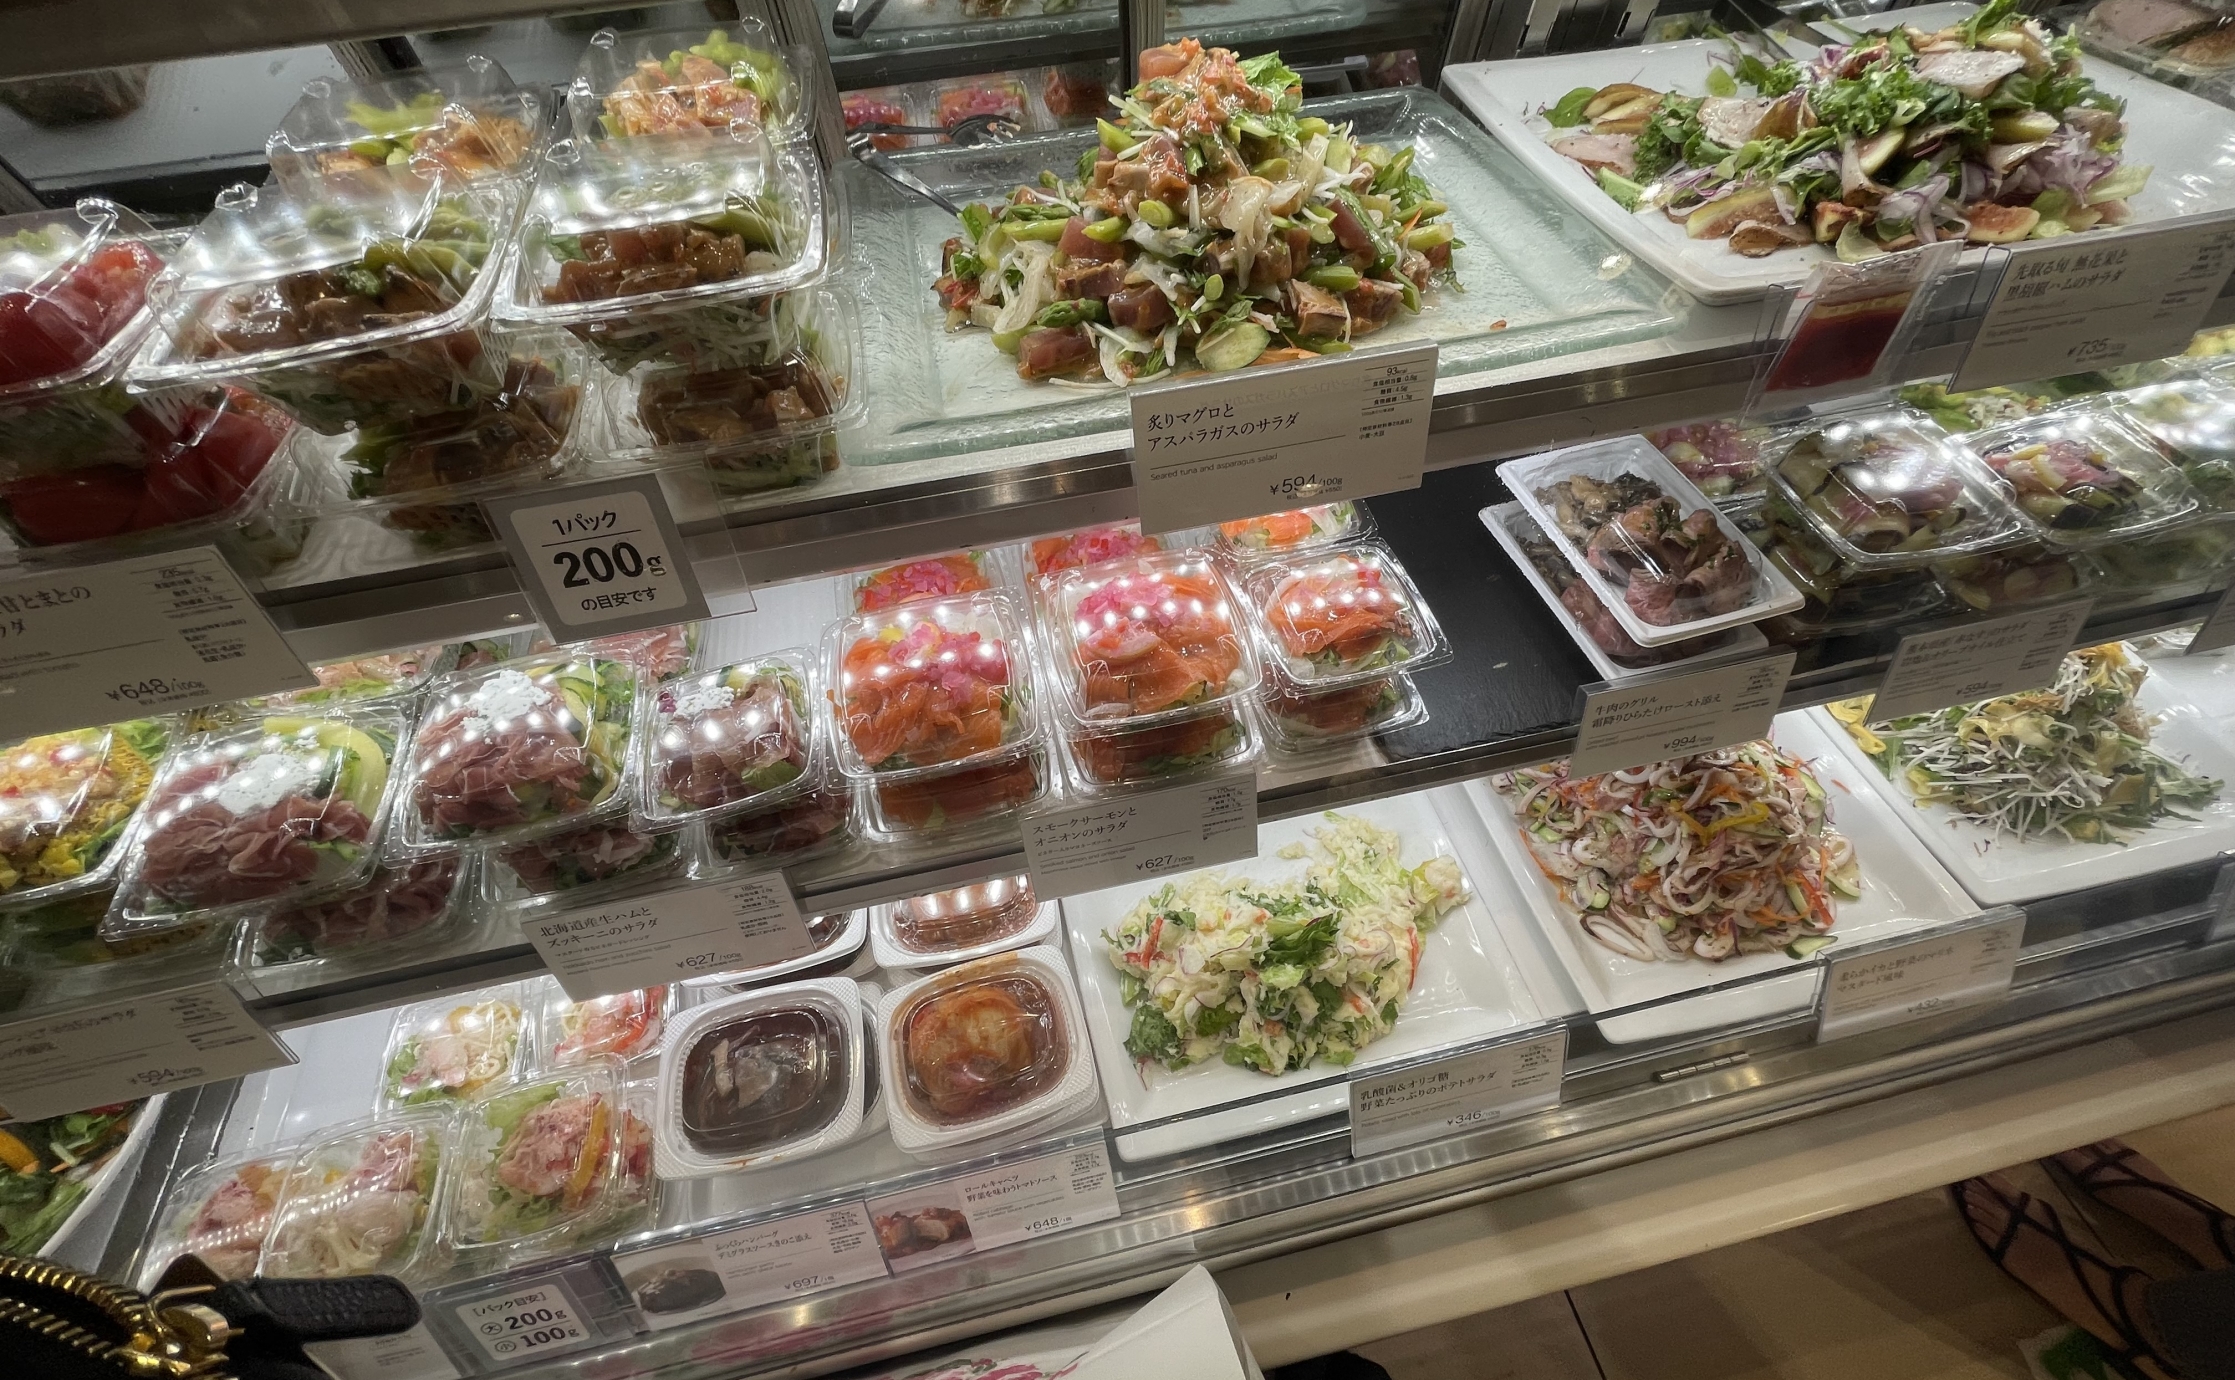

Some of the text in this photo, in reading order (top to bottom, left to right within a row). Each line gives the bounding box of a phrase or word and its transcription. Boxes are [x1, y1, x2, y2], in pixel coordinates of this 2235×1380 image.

[1147, 404, 1235, 433] 炙りマグロと
[1147, 412, 1300, 452] アスパラガスのサラダ
[1150, 452, 1278, 482] Seared tuna and asparagus salad
[552, 510, 617, 536] 1パック
[553, 541, 667, 589] 200g
[581, 586, 657, 611] の目安です
[1595, 695, 1660, 716] 牛肉のグリル
[1032, 806, 1138, 836] スモークサーモンと
[1035, 820, 1128, 847] オニオンのサラダ
[540, 907, 652, 938] 北海道産生ハムと
[547, 917, 659, 949] ズッキーニのサラダ
[1360, 1070, 1497, 1112] 野菜たっぷりのポテトサラダ
[965, 1175, 1019, 1193] ロールキャベツ
[966, 1175, 1058, 1203] 野菜を味わうトマトソース
[504, 1308, 567, 1331] 200g
[520, 1327, 580, 1348] 100g
